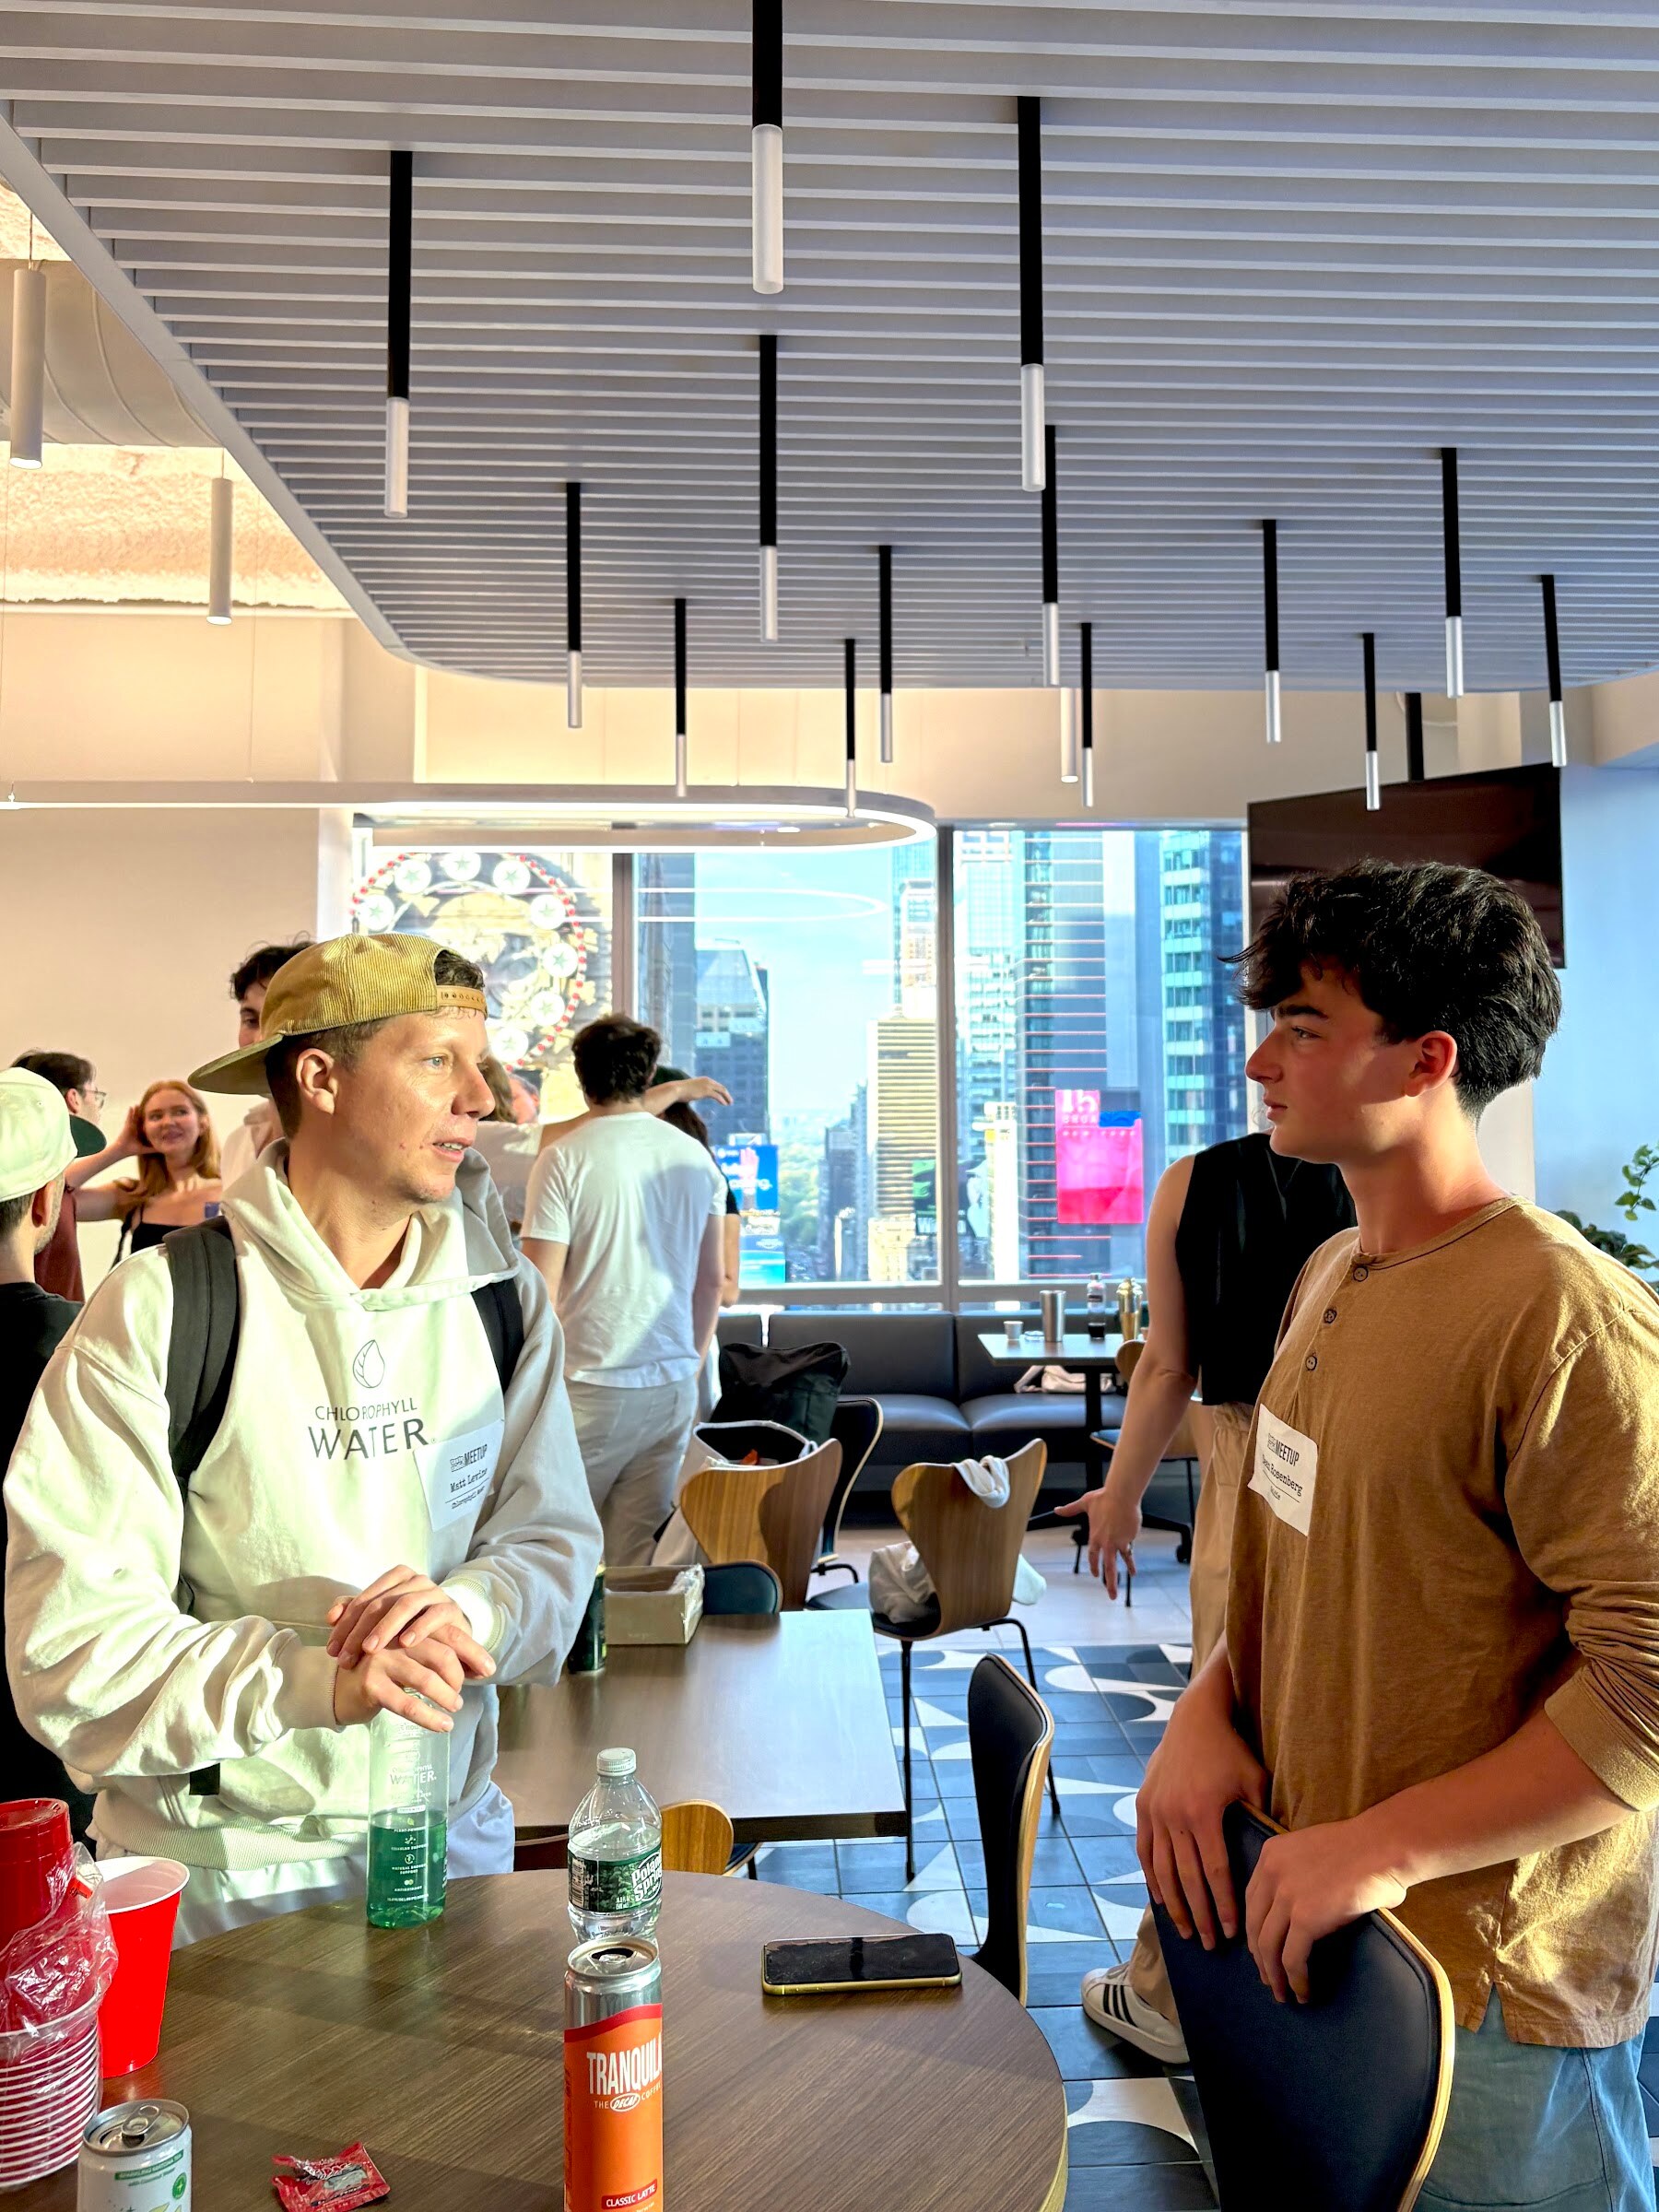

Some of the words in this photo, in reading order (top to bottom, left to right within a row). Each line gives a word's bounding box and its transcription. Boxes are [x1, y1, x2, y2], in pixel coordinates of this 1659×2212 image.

[314, 1397, 418, 1421] CHLOROPHYLL
[464, 1443, 488, 1467] MEETUP
[1276, 1439, 1300, 1466] MEETUP
[594, 2100, 609, 2110] THE
[606, 2194, 636, 2207] CLASSIC
[637, 2183, 656, 2201] LATTE
